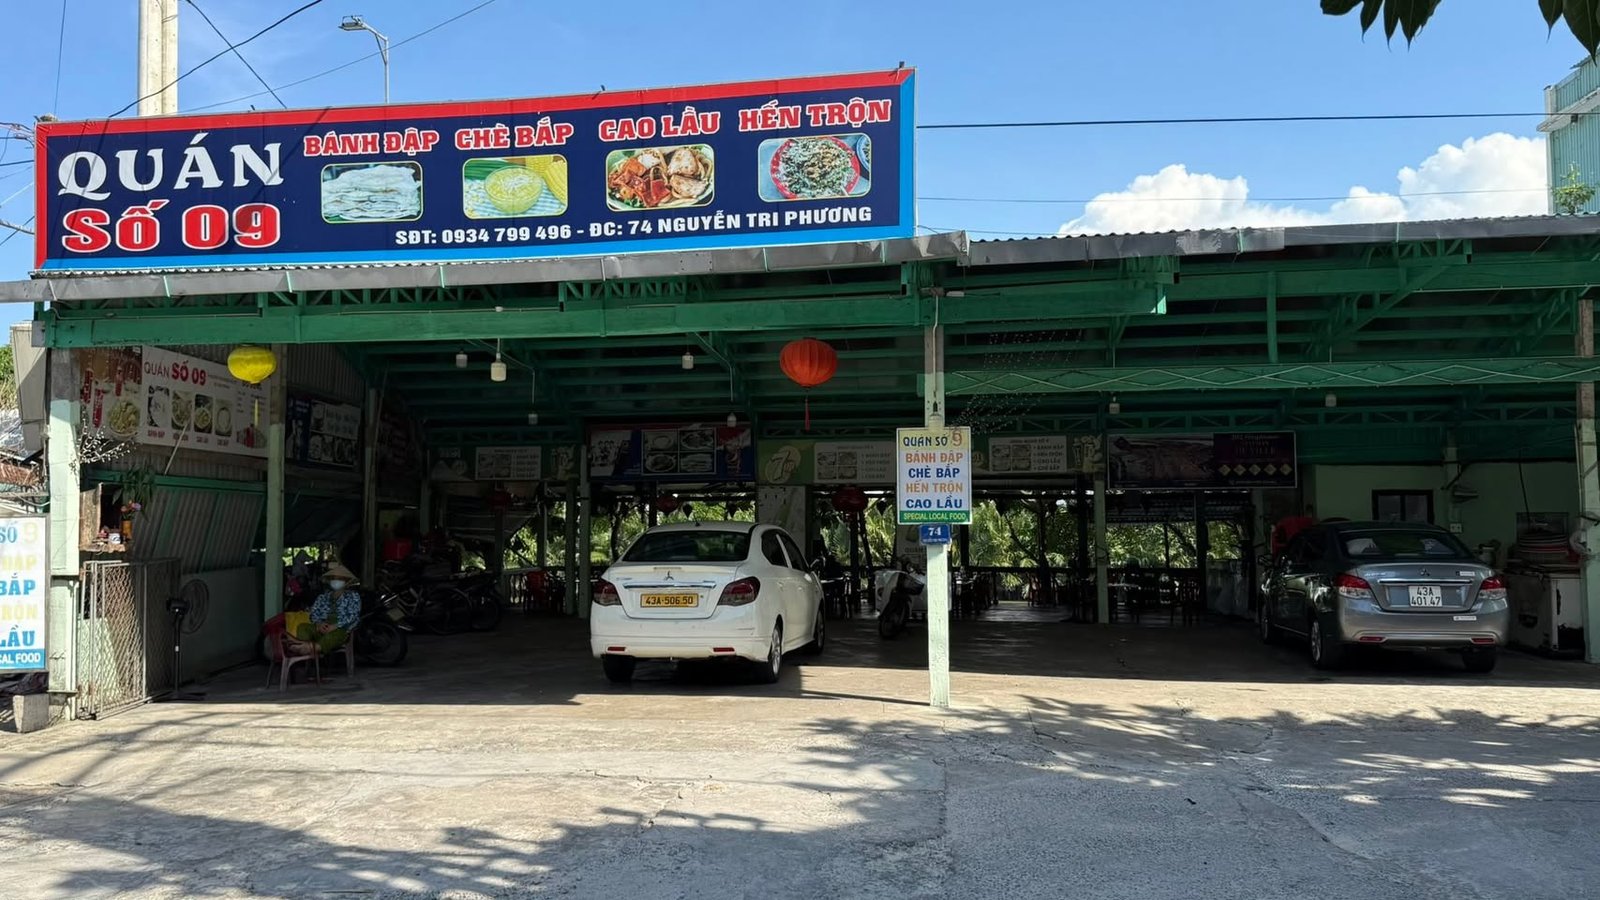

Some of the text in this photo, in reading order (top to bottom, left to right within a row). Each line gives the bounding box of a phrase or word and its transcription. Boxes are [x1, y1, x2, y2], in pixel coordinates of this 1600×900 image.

[738, 97, 893, 133] HẾN TRỘN
[454, 116, 575, 151] CHÈ BẮP
[598, 106, 722, 143] CAO LẦU
[303, 127, 440, 157] BÁNH ĐẬP
[58, 132, 284, 200] QUÁN
[62, 198, 281, 252] SỐ 09
[395, 229, 437, 246] SĐT:
[441, 228, 490, 244] 0934
[494, 226, 531, 242] 799
[535, 224, 572, 240] 496
[589, 221, 623, 237] ĐC:
[628, 219, 653, 235] 74
[657, 210, 739, 233] NGUYỄN
[745, 212, 780, 229] TRI
[784, 206, 872, 226] PHƯƠNG
[144, 361, 170, 378] QUÁN
[171, 360, 189, 381] SỐ
[191, 369, 207, 386] 09
[903, 434, 932, 446] QUÁN
[935, 434, 948, 446] SỐ
[906, 450, 963, 464] BÁNH ĐẬP
[908, 463, 960, 478] CHÈ BẮP
[906, 480, 963, 494] HẾN TRỘN
[906, 495, 962, 508] CAO LẦU
[903, 512, 967, 520] SPECIAL LOCAL FOOD
[928, 527, 941, 536] 74
[1417, 586, 1434, 596] 43A
[0, 601, 38, 622] RỘN
[15, 652, 41, 664] FOOD
